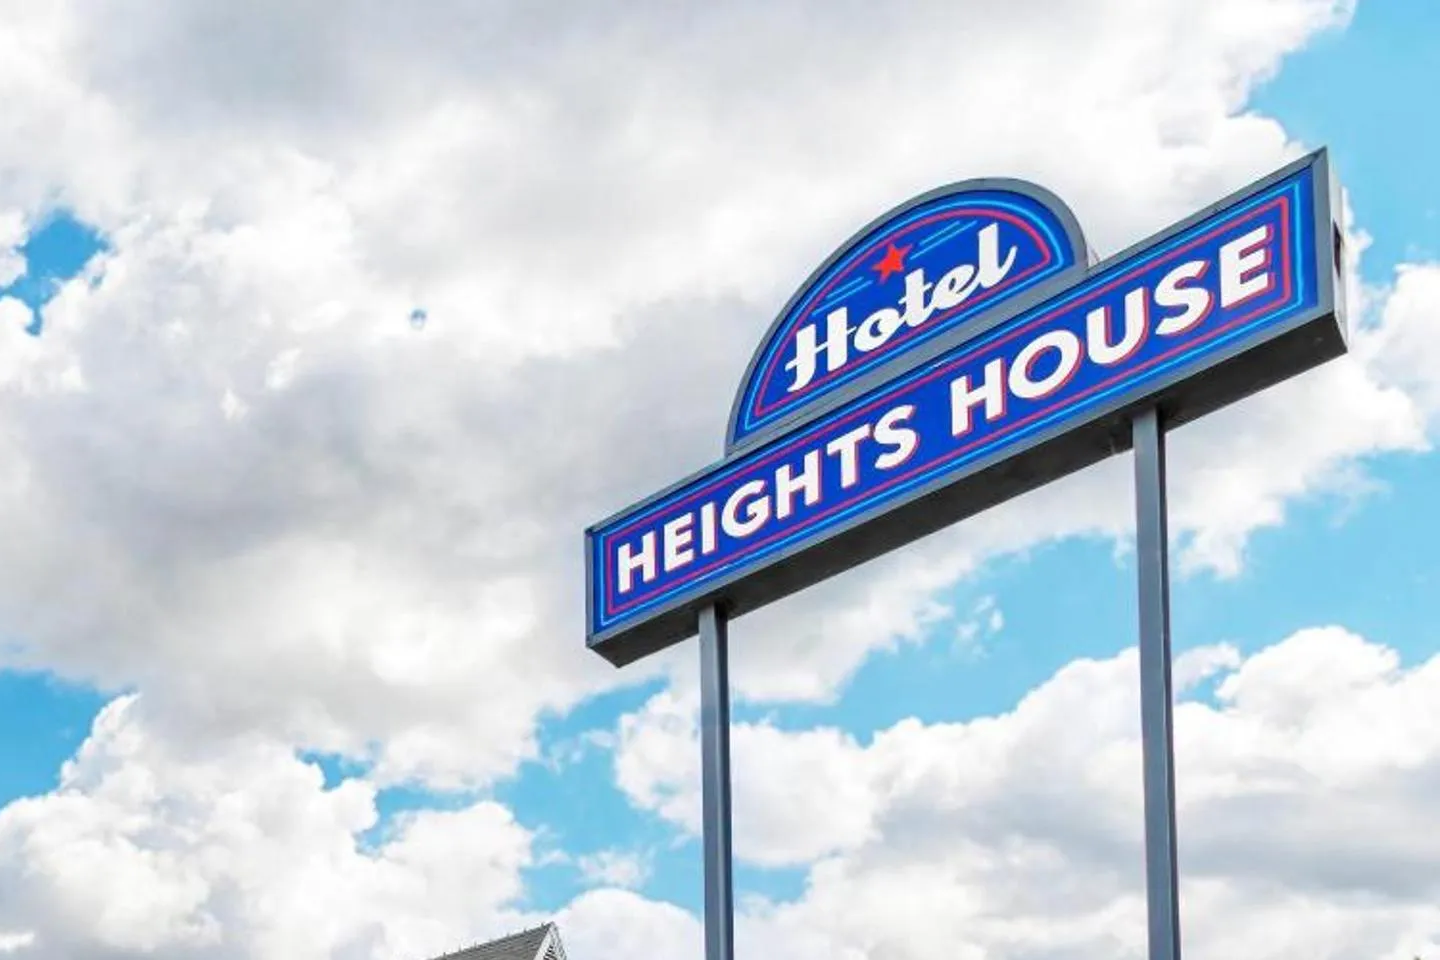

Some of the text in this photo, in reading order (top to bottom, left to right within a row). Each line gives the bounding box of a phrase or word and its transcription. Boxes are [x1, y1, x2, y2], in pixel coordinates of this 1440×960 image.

[617, 223, 1274, 595] HEIGHTS HOUSE
[785, 223, 1018, 392] Hotel
